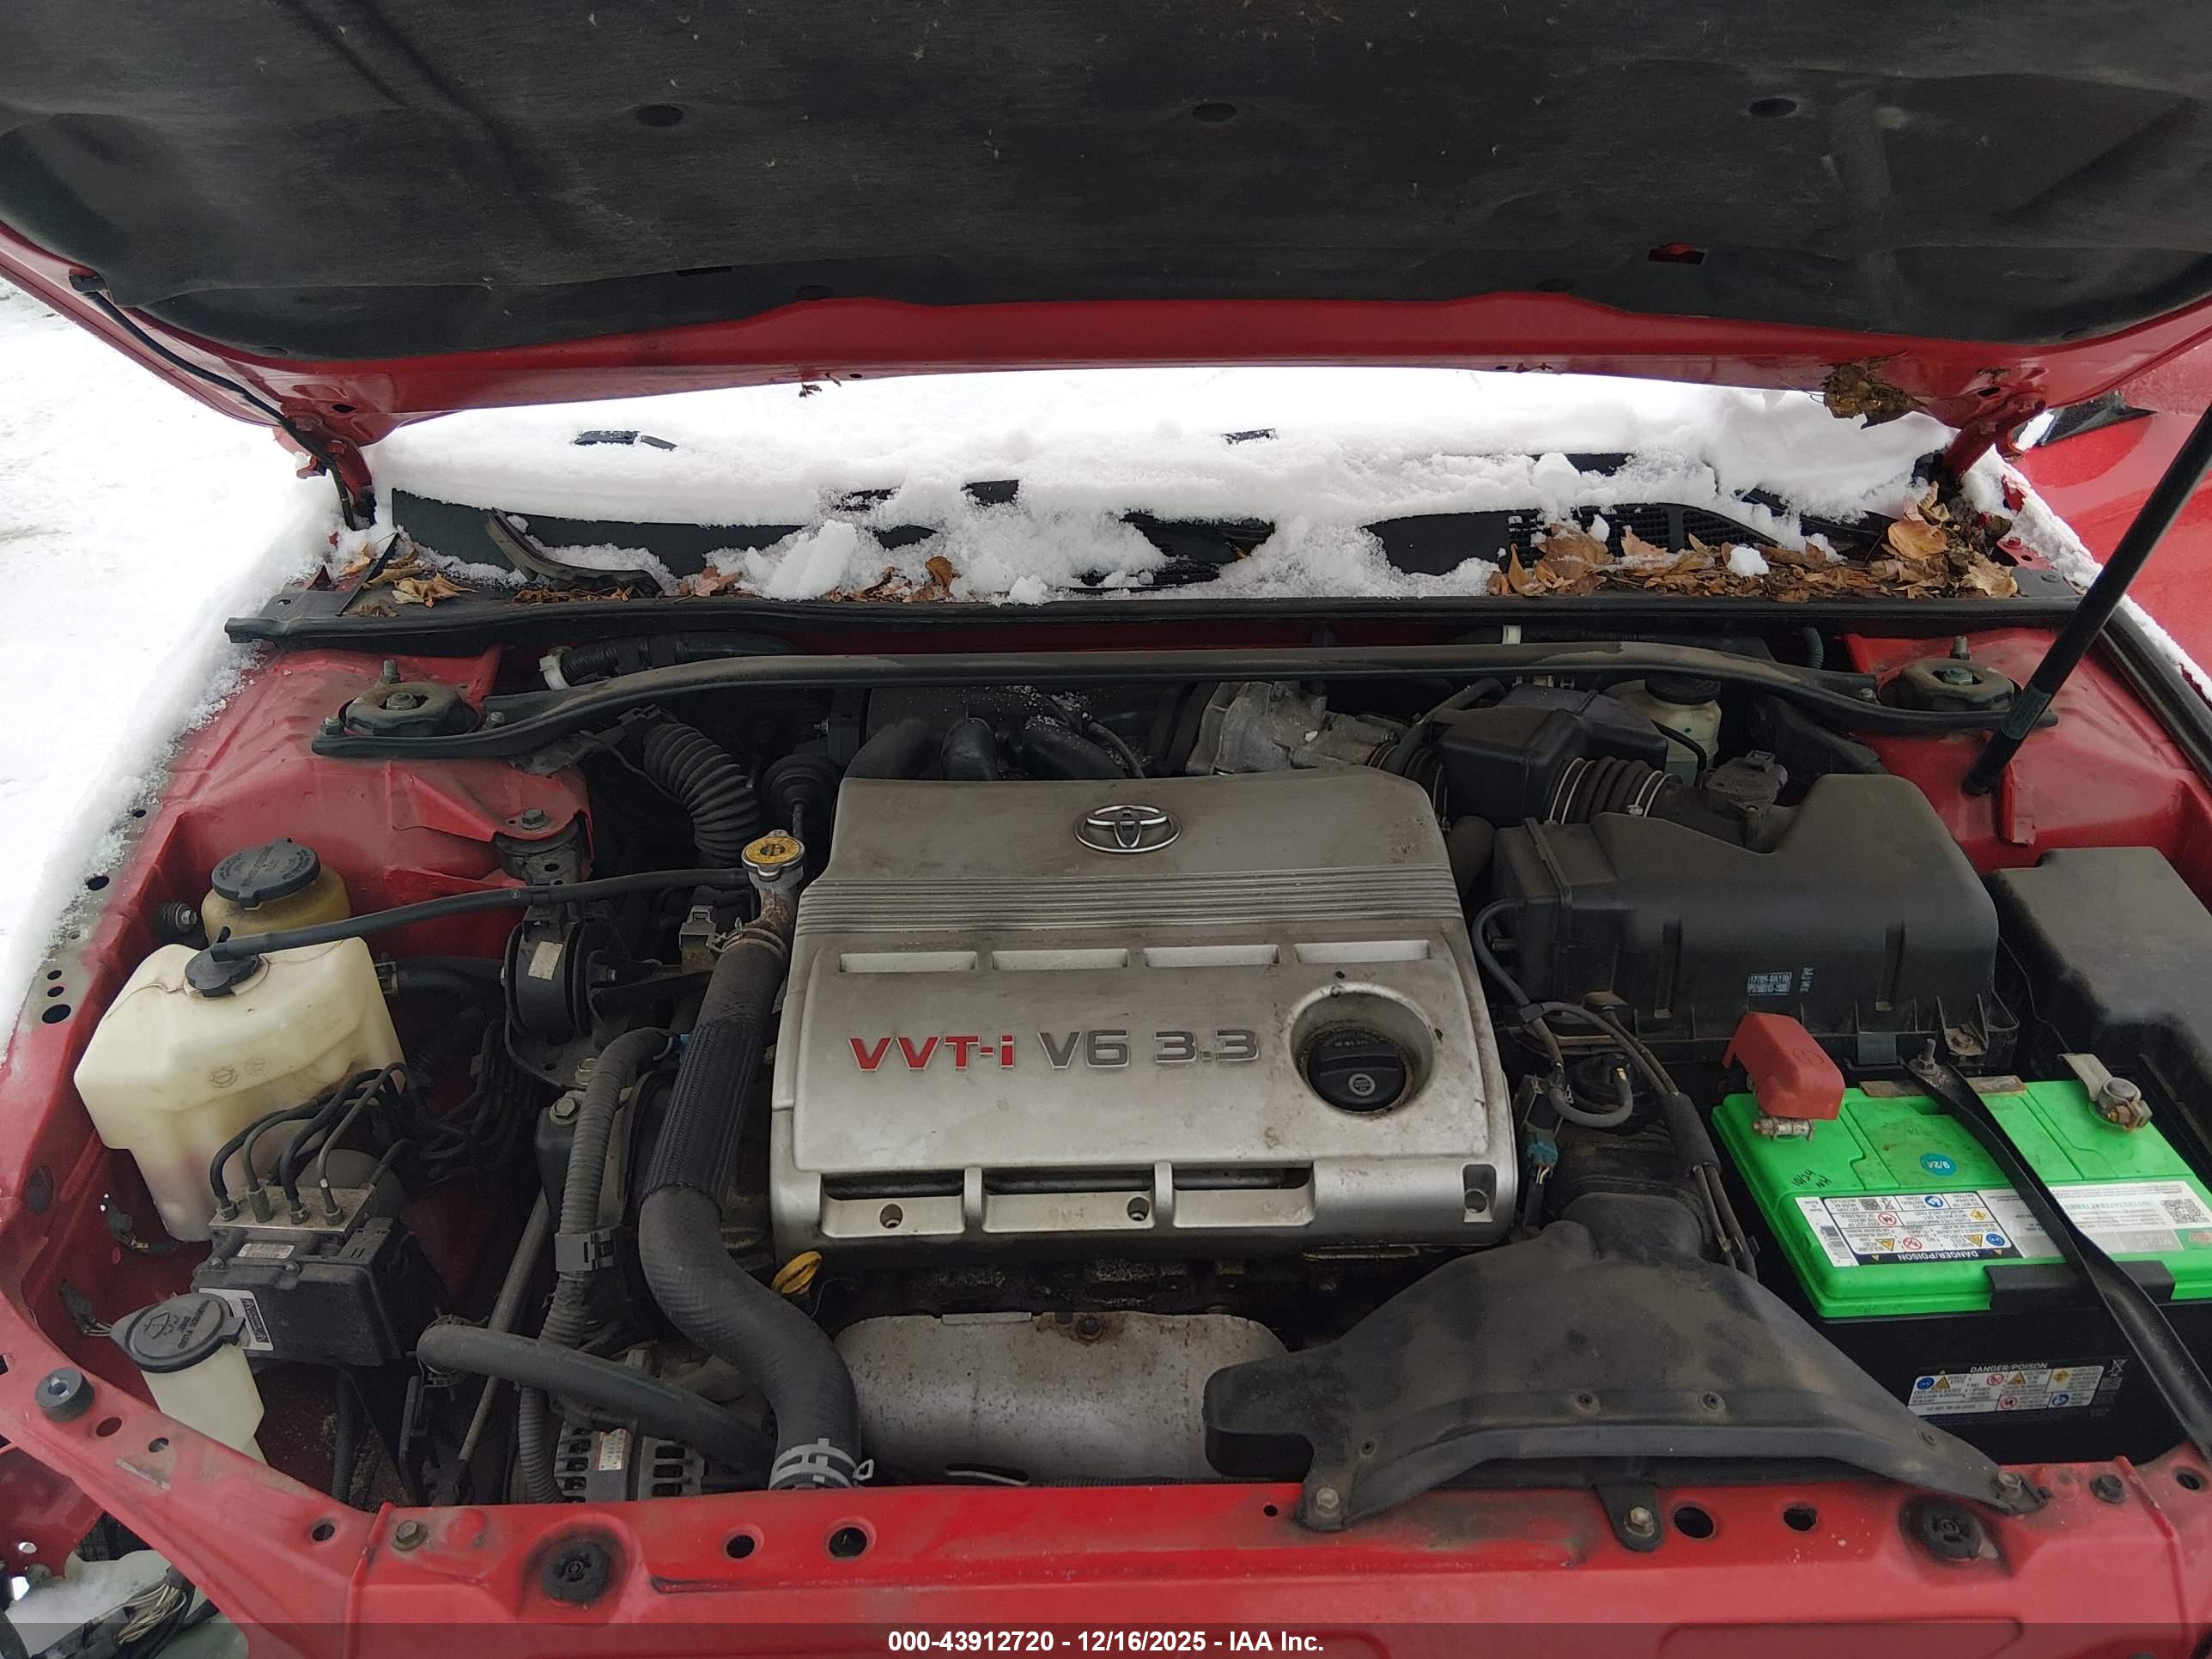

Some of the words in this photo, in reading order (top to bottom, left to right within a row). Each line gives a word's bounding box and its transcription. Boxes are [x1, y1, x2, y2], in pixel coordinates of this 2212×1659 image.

[848, 1034, 1015, 1072] VVT-i
[1038, 1030, 1130, 1070] V6
[1153, 1030, 1260, 1066] 3.3
[1895, 1249, 1980, 1261] DANGER/POISON
[1970, 1362, 2048, 1375] DANGER/POISON
